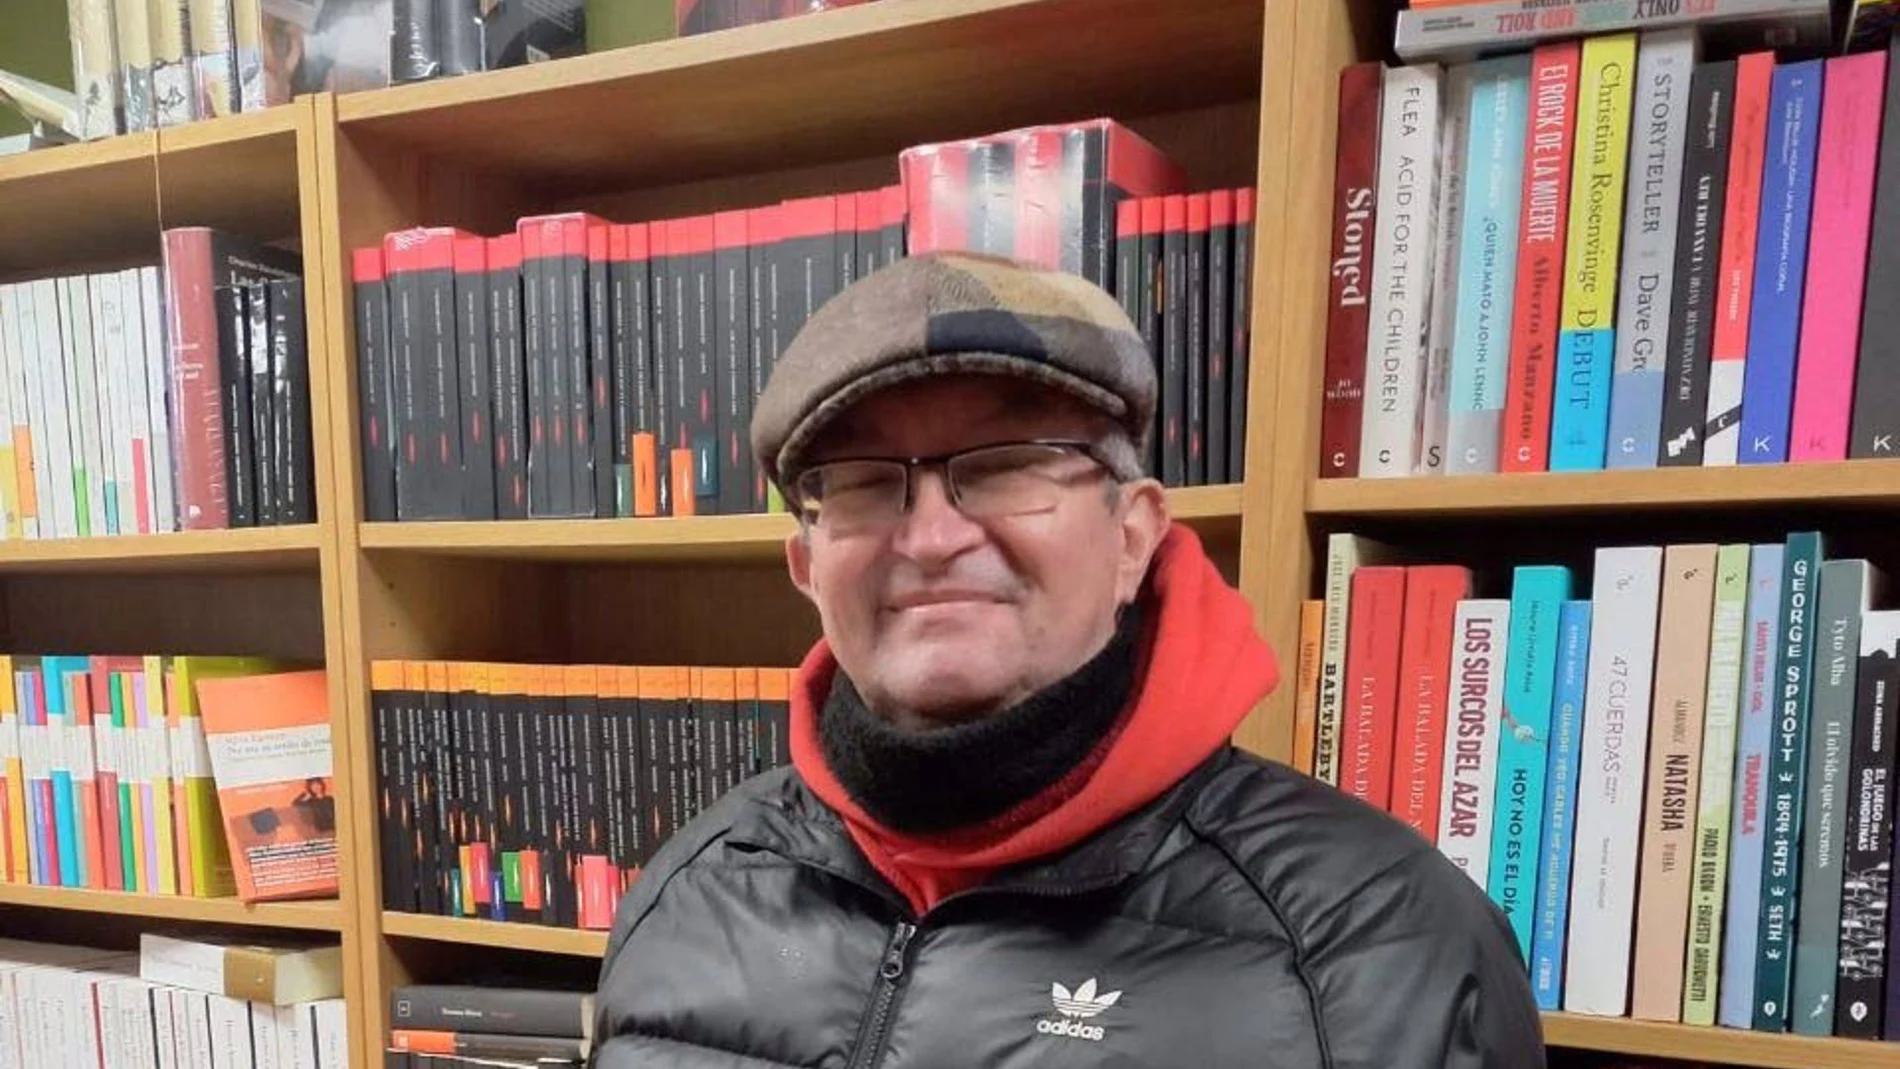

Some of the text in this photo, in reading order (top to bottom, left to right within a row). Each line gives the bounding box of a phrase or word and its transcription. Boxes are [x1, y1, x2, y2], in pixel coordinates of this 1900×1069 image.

[1496, 12, 1538, 34] ROLL
[1632, 0, 1680, 21] ONLY
[1534, 82, 1566, 132] ROCK
[1533, 131, 1562, 154] DE
[1642, 72, 1673, 234] STORYTELLER
[1532, 155, 1560, 178] LA
[1527, 178, 1558, 244] MUERTE
[1332, 186, 1373, 307] Stoned
[1382, 87, 1421, 414] FLEA ACID FOR THE CHILDREN
[1568, 62, 1622, 410] Christina Rosenvinge DEBUT
[1480, 271, 1493, 310] MATO
[1632, 273, 1660, 331] Dave
[1479, 313, 1488, 325] A
[1476, 326, 1489, 363] JOHN
[1521, 343, 1543, 440] Manzano
[1754, 434, 1772, 453] K
[1873, 434, 1893, 453] K
[1610, 655, 1629, 678] 47
[1829, 618, 1848, 687] Tyto Alba
[1360, 676, 1376, 698] LA
[1416, 674, 1435, 697] LA
[1318, 661, 1338, 782] BARTLEBY
[1354, 703, 1374, 776] BALADA
[1412, 702, 1433, 775] BALADA
[1448, 618, 1493, 838] LOS SURCOS DEL AZAR
[1602, 679, 1627, 773] CUERDAS
[1766, 559, 1808, 941] GEORGE SPROTT 1894-1975 SETH
[1510, 769, 1528, 808] HOY
[1659, 754, 1690, 832] NATASHA
[1874, 767, 1887, 782] EL
[1408, 779, 1426, 817] DEL
[1741, 753, 1762, 836] TRANQUILA
[1817, 721, 1841, 869] El olvido que seremos
[1857, 767, 1874, 852] GOLONDRINAS
[1871, 783, 1886, 821] JUEGO
[1508, 810, 1523, 838] NO
[1868, 835, 1879, 852] LAS
[1505, 840, 1521, 862] ES
[1503, 863, 1518, 884] EL
[1036, 1019, 1106, 1042] adidas
